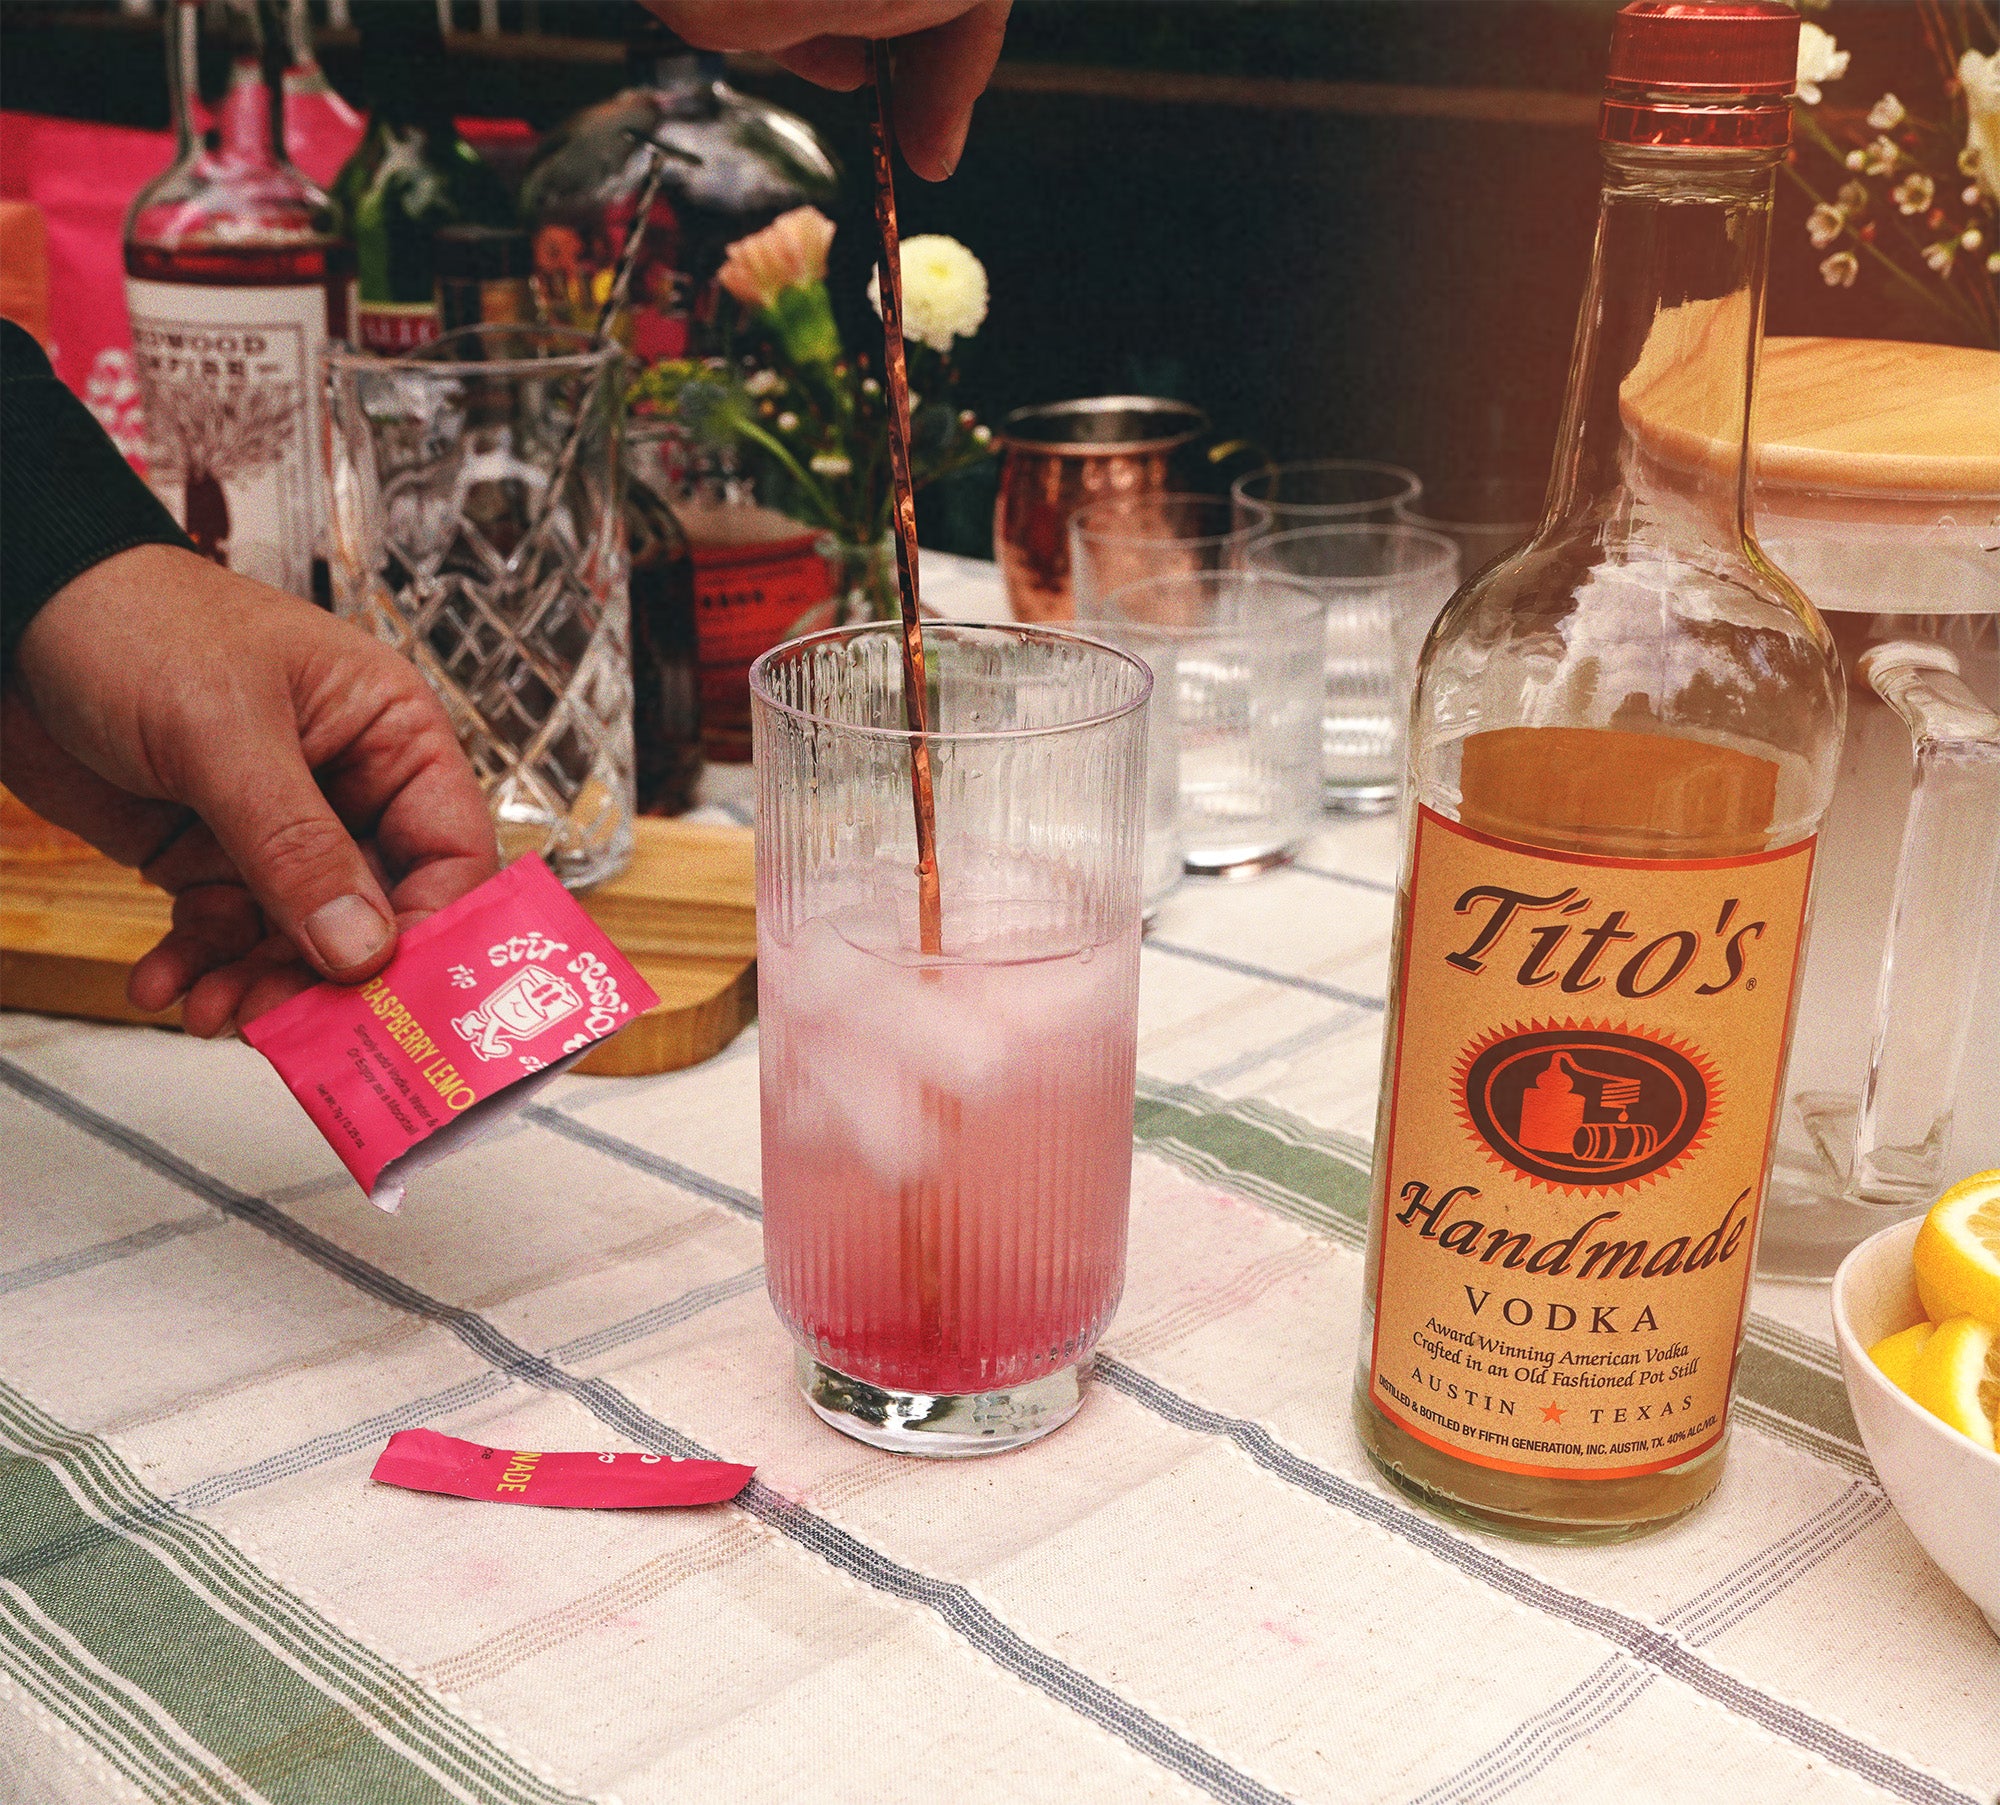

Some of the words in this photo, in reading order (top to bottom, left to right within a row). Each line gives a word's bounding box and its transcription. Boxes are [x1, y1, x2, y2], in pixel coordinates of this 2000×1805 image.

[447, 964, 477, 989] rip
[487, 931, 569, 967] stir
[563, 952, 629, 1053] sessio
[359, 976, 440, 1064] RASPBERRY
[423, 1057, 476, 1110] LEMO
[1395, 1180, 1752, 1281] Handmade
[1463, 1285, 1659, 1334] VODKA
[1412, 1331, 1462, 1364] Crafted
[1466, 1355, 1483, 1372] in
[1487, 1364, 1509, 1379] an
[1514, 1366, 1548, 1386] Old
[1552, 1369, 1636, 1388] Fashioned
[1639, 1370, 1666, 1387] Pot
[1669, 1357, 1701, 1380] Still
[1425, 1316, 1476, 1347] Award
[1478, 1335, 1556, 1368] Winning
[1558, 1350, 1641, 1367] American
[1645, 1341, 1690, 1364] Vodka
[1378, 1374, 1411, 1407] DISTILLED
[1411, 1401, 1419, 1413] &
[1419, 1404, 1460, 1433] BOTTLED
[1462, 1424, 1477, 1438] BY
[1478, 1430, 1510, 1447] FIFTH
[1511, 1437, 1584, 1457] GENERATION,
[1586, 1444, 1607, 1456] INC.
[1610, 1440, 1650, 1456] AUSTIN,
[1650, 1437, 1665, 1449] TX.
[1666, 1431, 1687, 1445] 40%
[1411, 1367, 1517, 1417] AUSTIN
[1589, 1395, 1692, 1424] TEXAS
[496, 1451, 542, 1492] NADE
